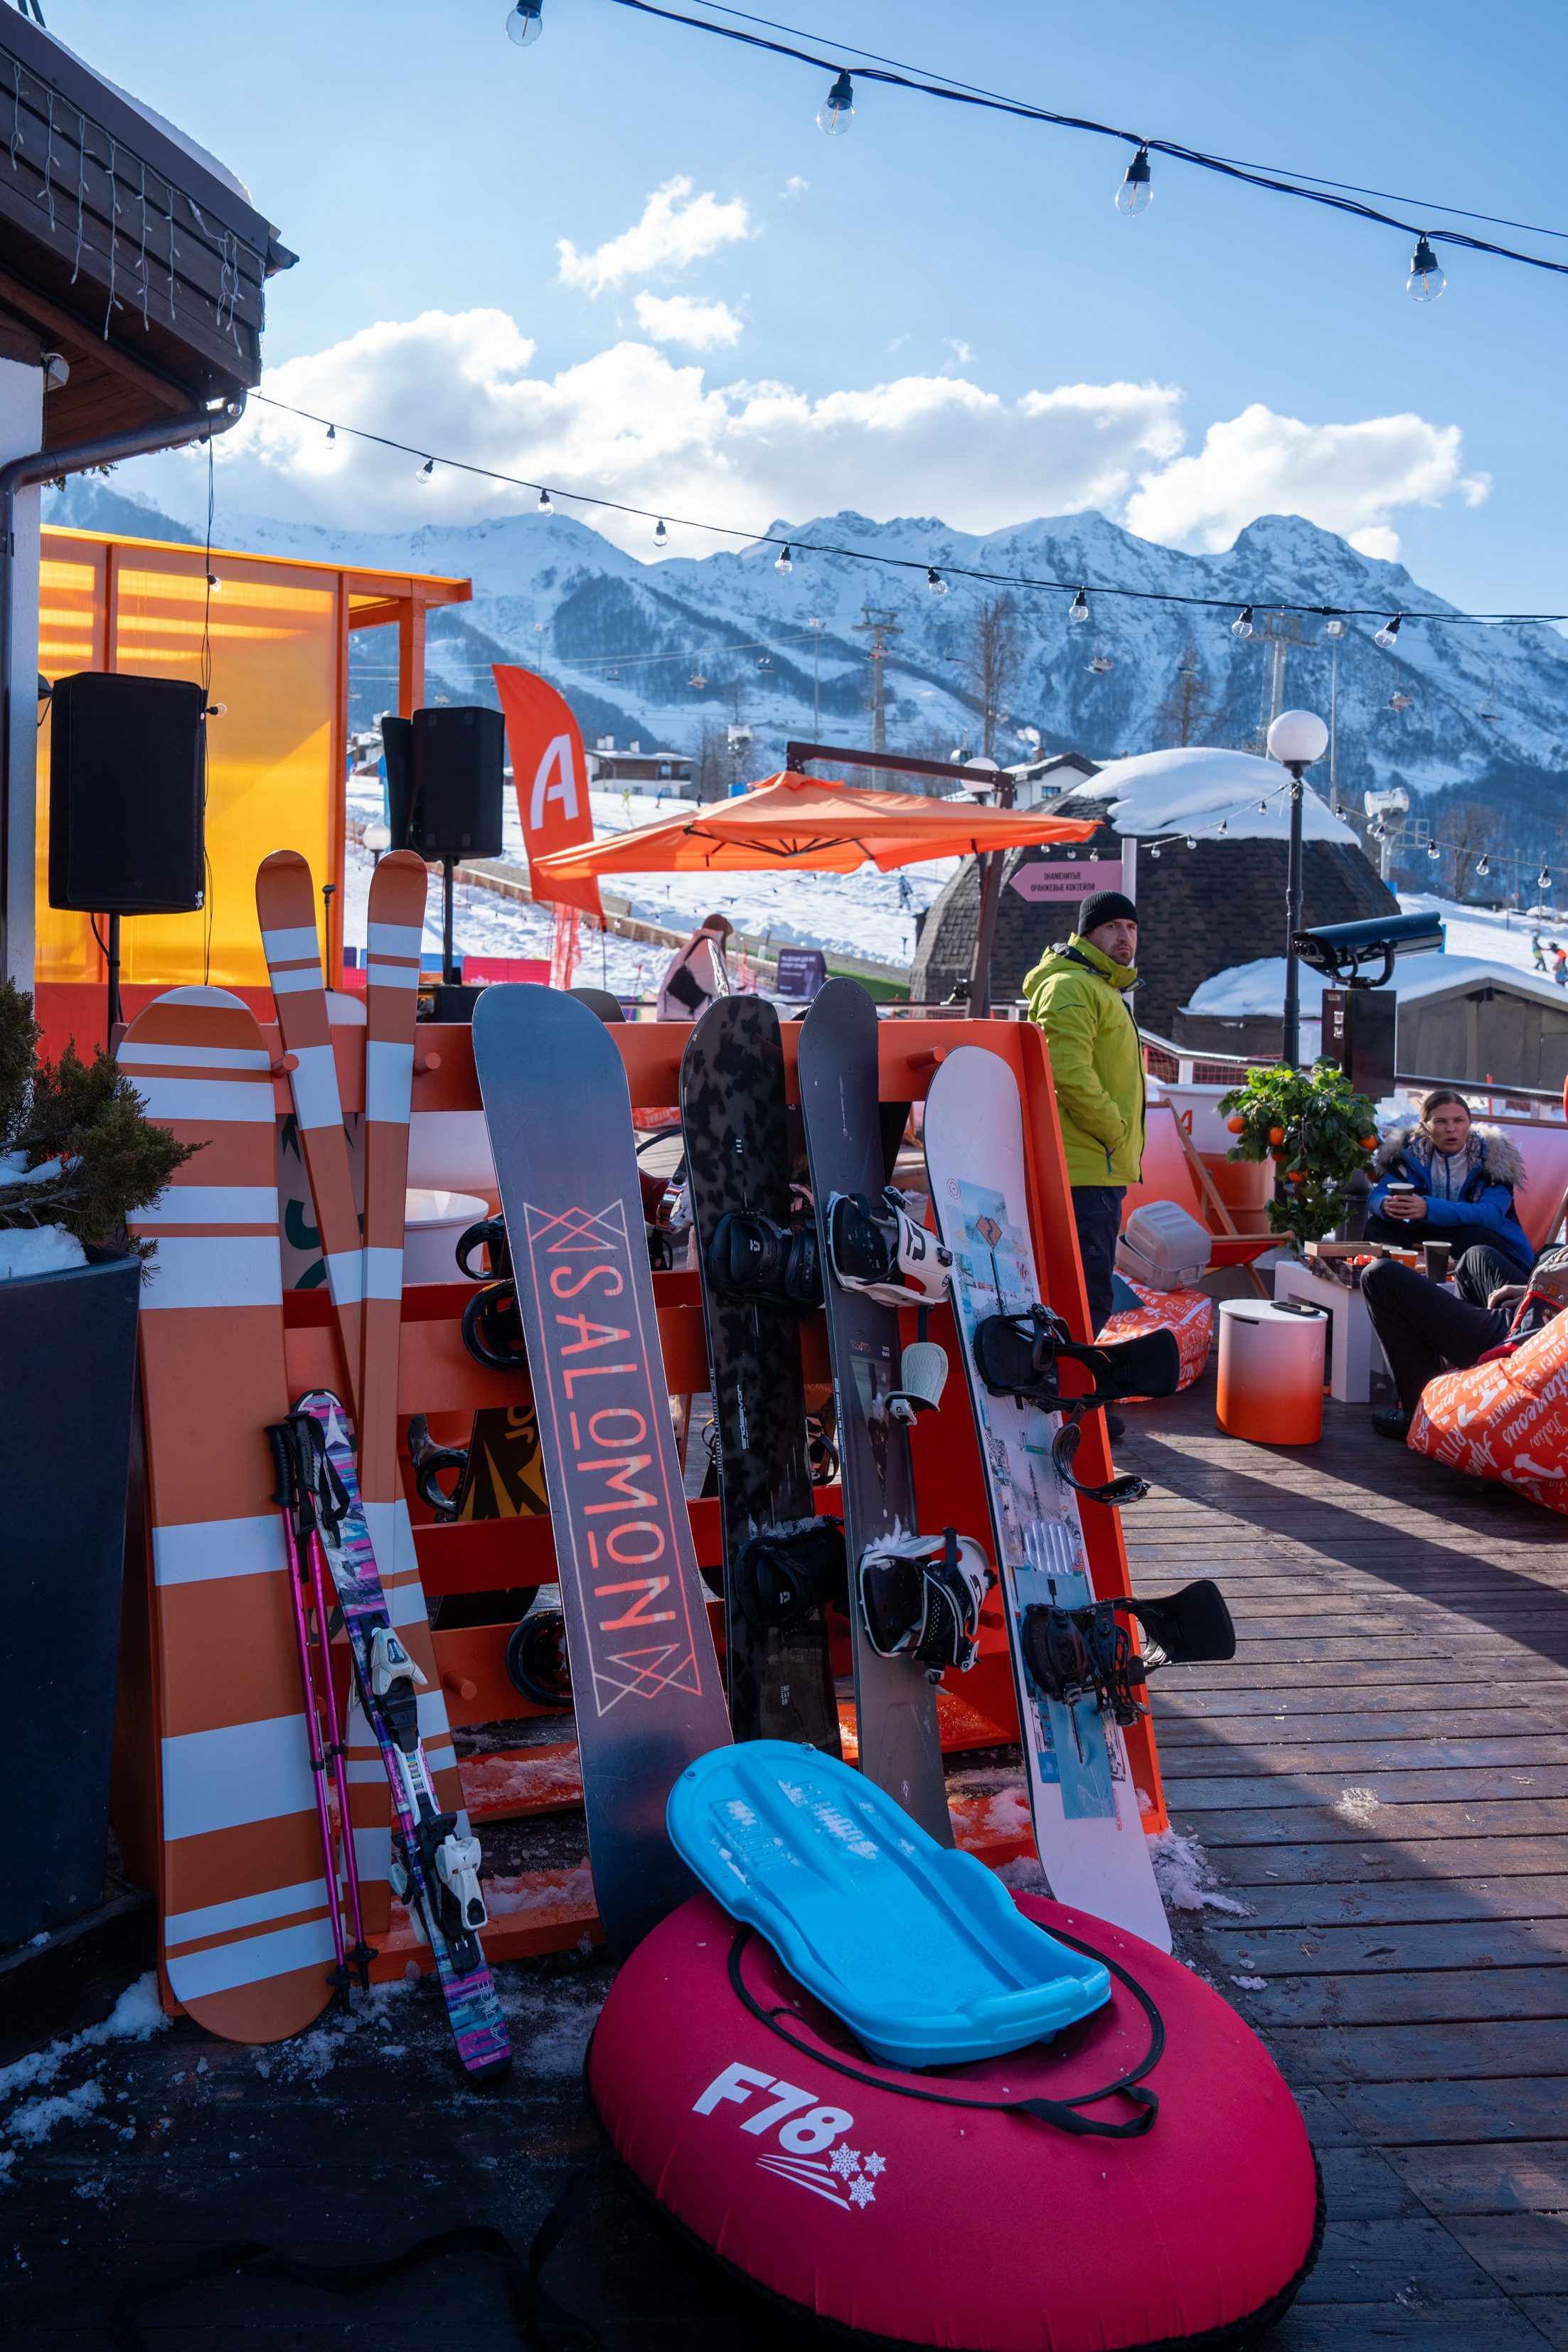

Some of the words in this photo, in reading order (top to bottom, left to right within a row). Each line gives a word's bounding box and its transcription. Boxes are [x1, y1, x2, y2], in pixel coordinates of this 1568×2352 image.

[530, 733, 580, 831] A
[1043, 872, 1082, 880] ЗНАМЕНИТЫЕ
[1065, 882, 1095, 891] КОКТЕЙЛИ
[737, 1384, 747, 1450] endeavor
[1486, 1368, 1540, 1428] SELZIONATE
[550, 1265, 676, 1632] SALOMON
[387, 1753, 403, 1799] BEND-X
[477, 1979, 506, 2049] VANTAGE
[484, 2052, 501, 2061] ATOMIC
[692, 2061, 854, 2155] F78
